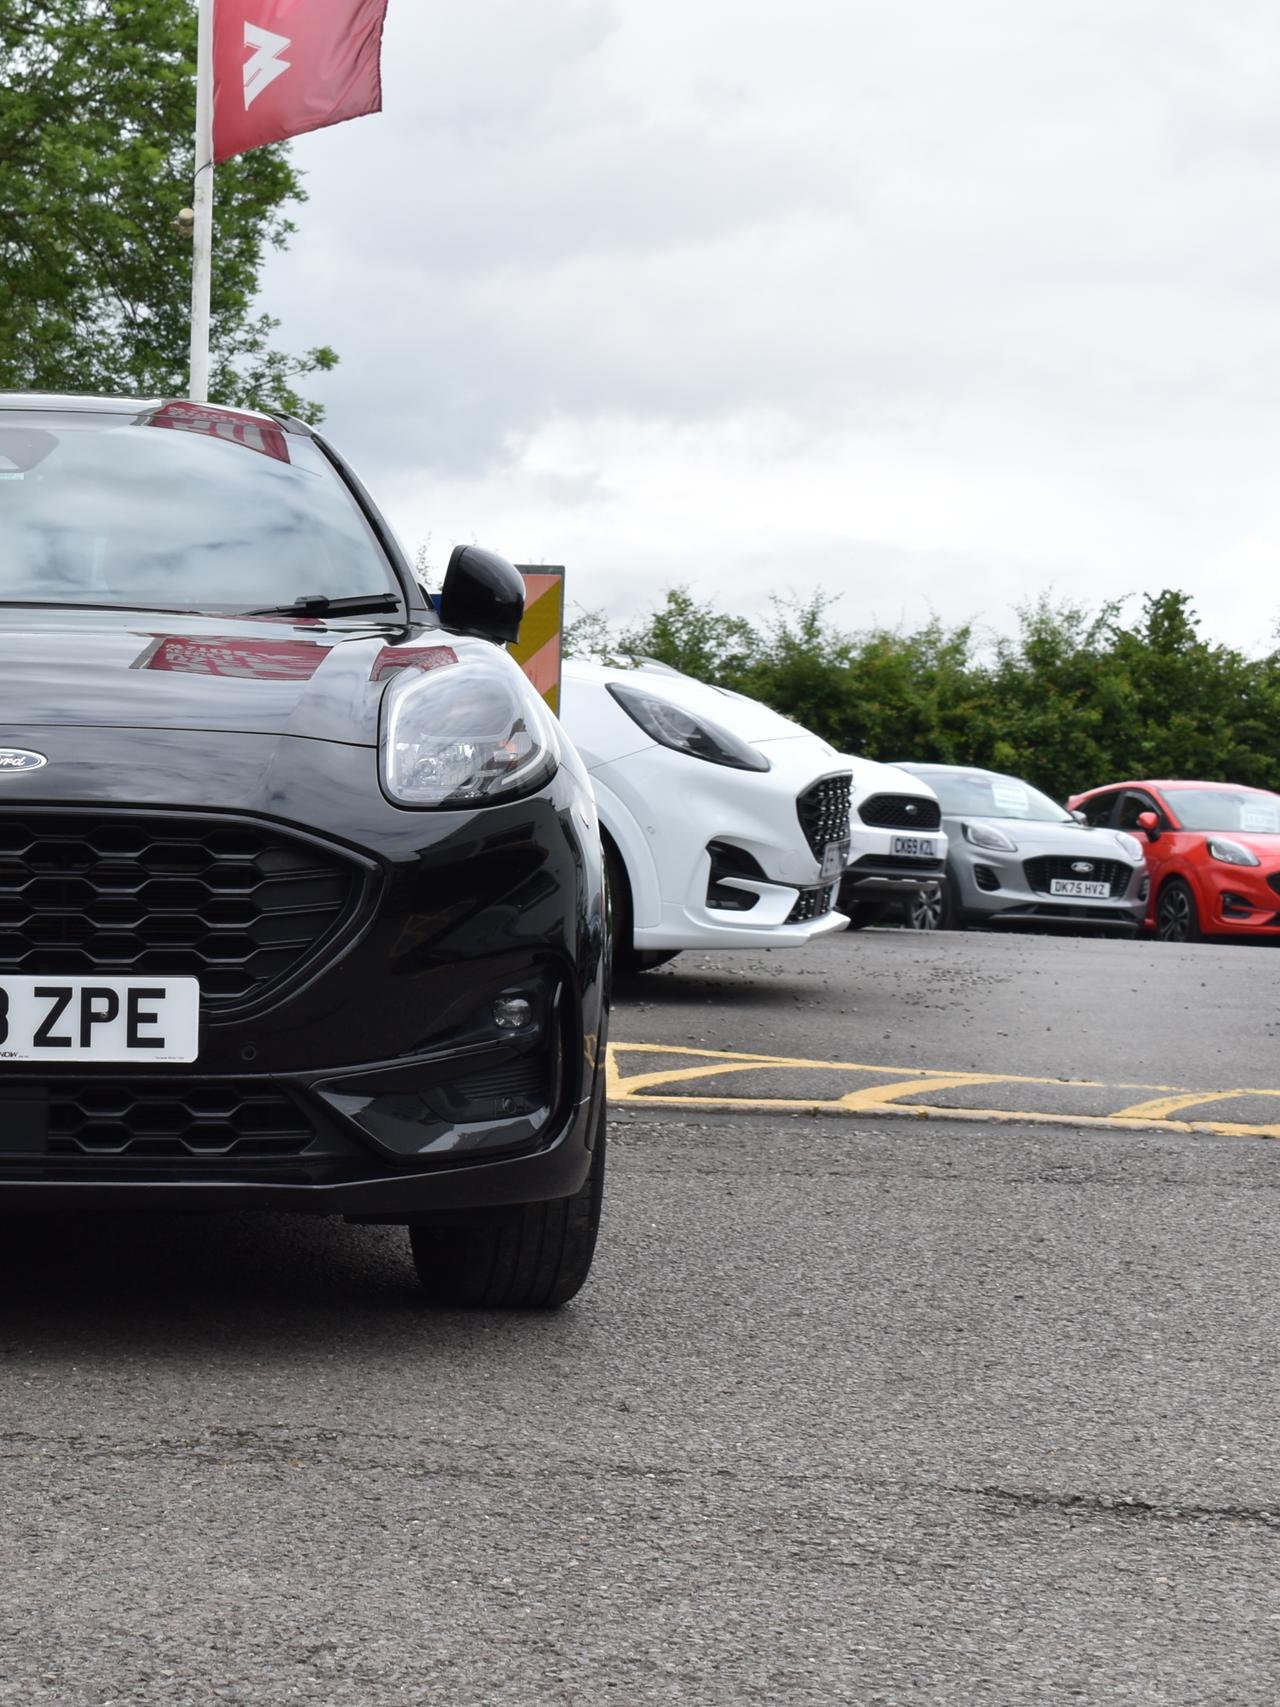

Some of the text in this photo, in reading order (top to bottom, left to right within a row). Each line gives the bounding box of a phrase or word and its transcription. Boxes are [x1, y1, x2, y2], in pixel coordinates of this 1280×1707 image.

[1055, 881, 1105, 896] DK75 HVZ
[32, 986, 166, 1048] ZPE
